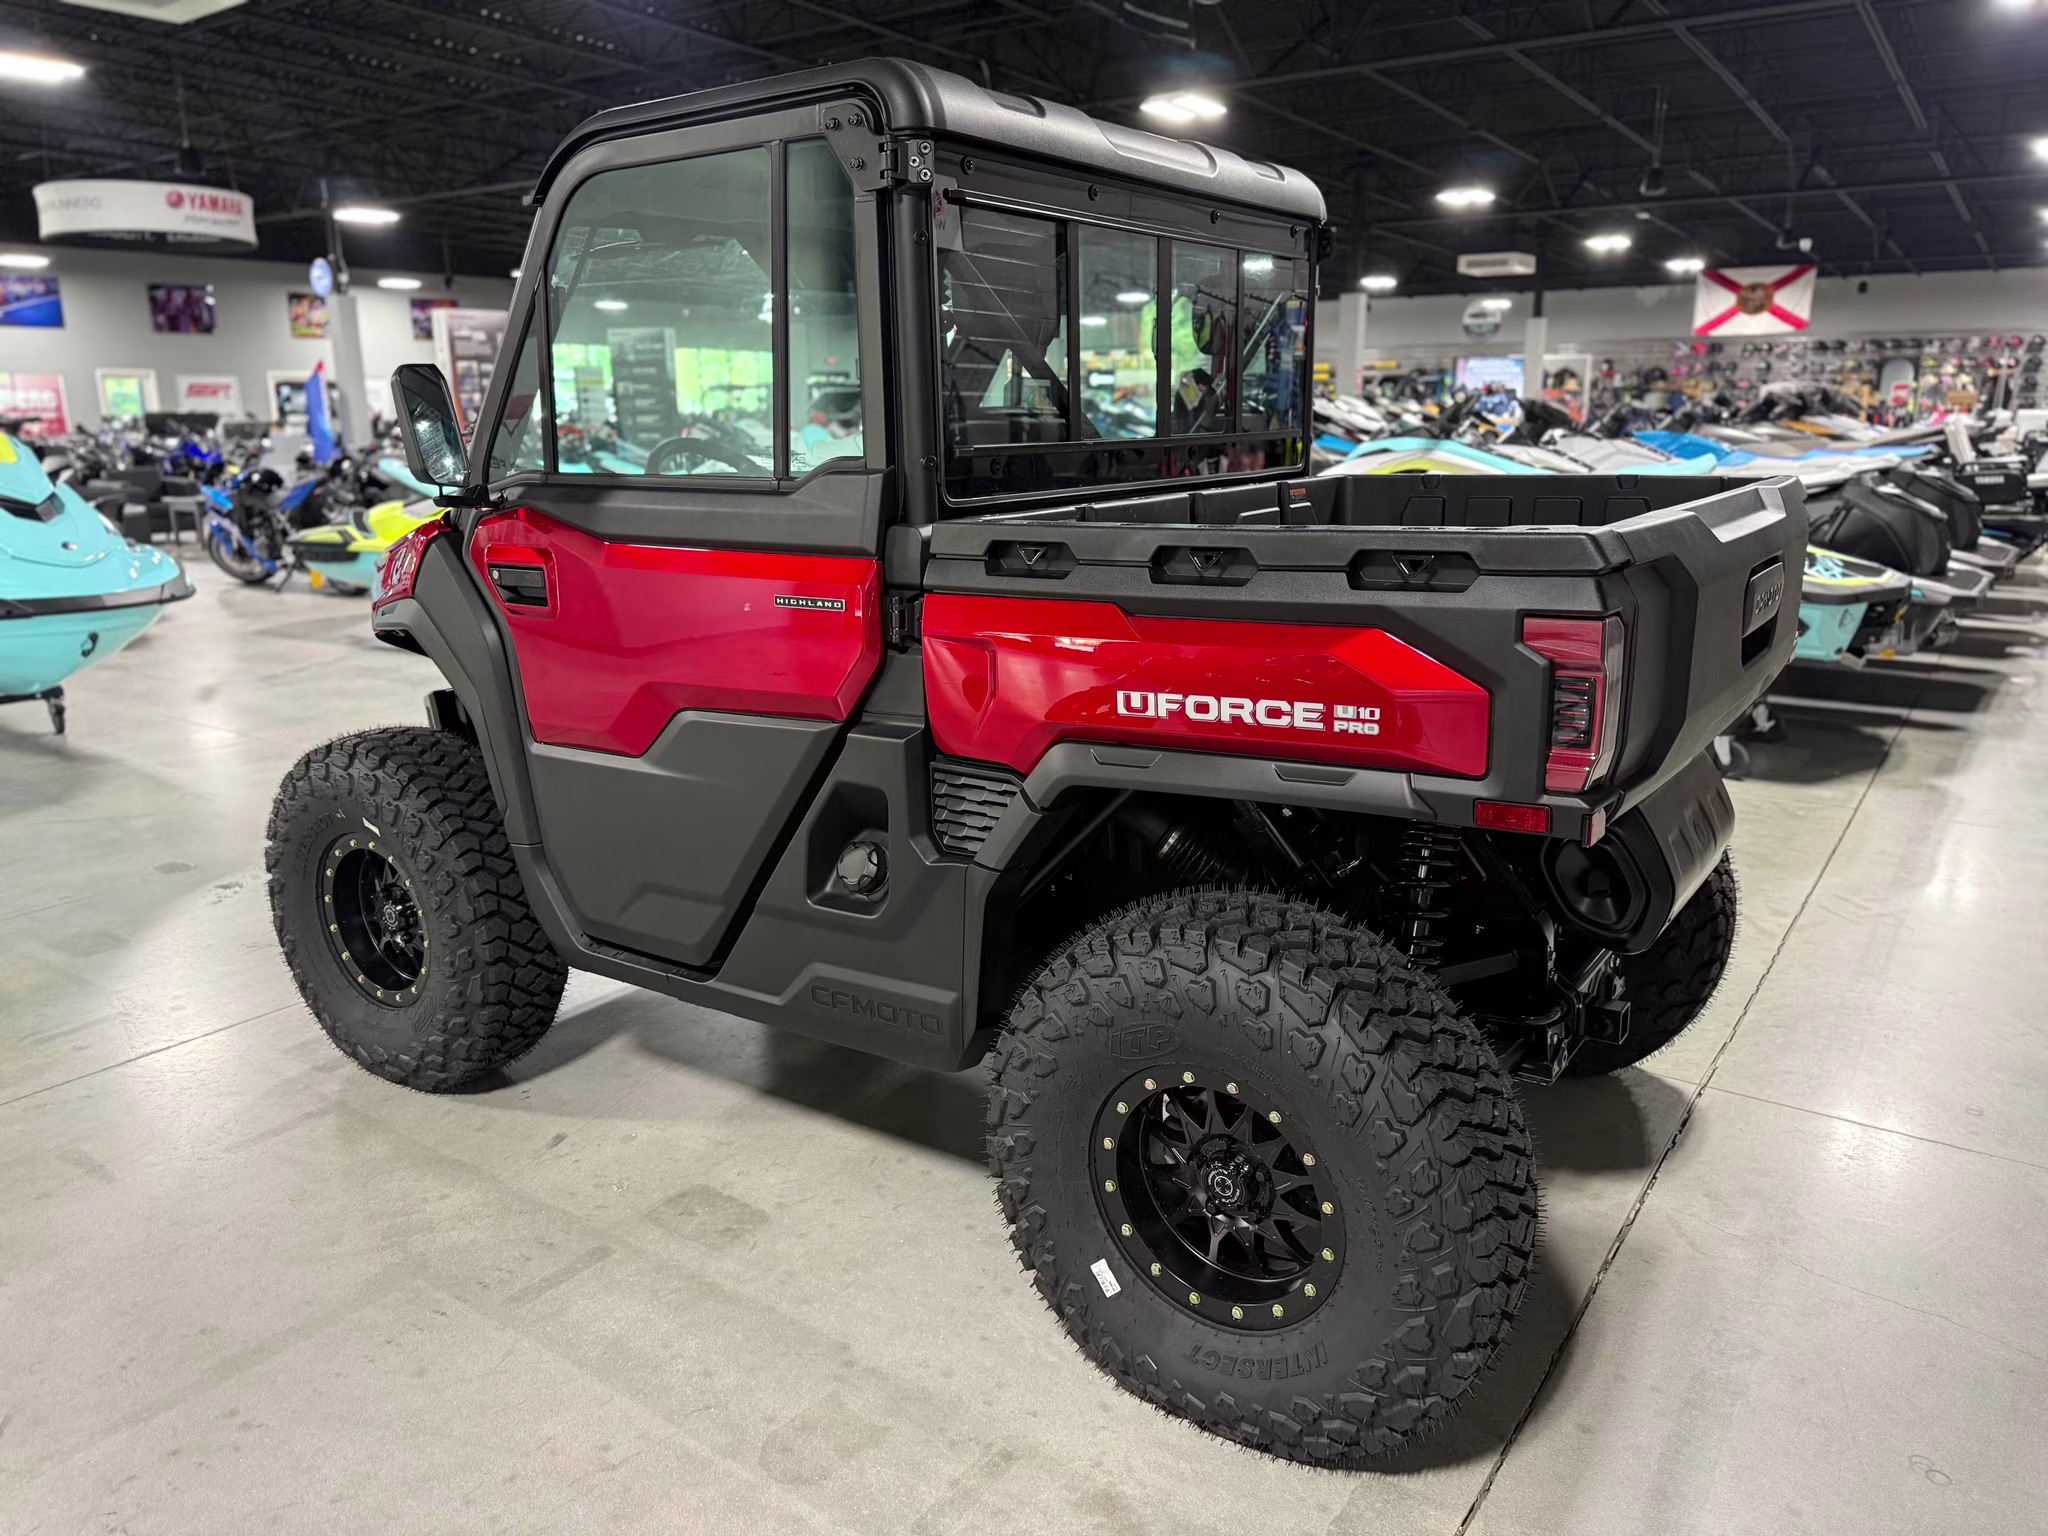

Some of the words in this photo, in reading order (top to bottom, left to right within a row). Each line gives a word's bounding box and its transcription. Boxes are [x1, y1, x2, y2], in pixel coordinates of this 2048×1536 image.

[776, 597, 842, 608] HIGHLAND
[1334, 704, 1381, 721] U10
[1333, 720, 1381, 736] PRO
[811, 985, 941, 1036] CFMOTO
[1111, 1024, 1172, 1058] ITP
[1182, 1339, 1329, 1380] INTERSECT
